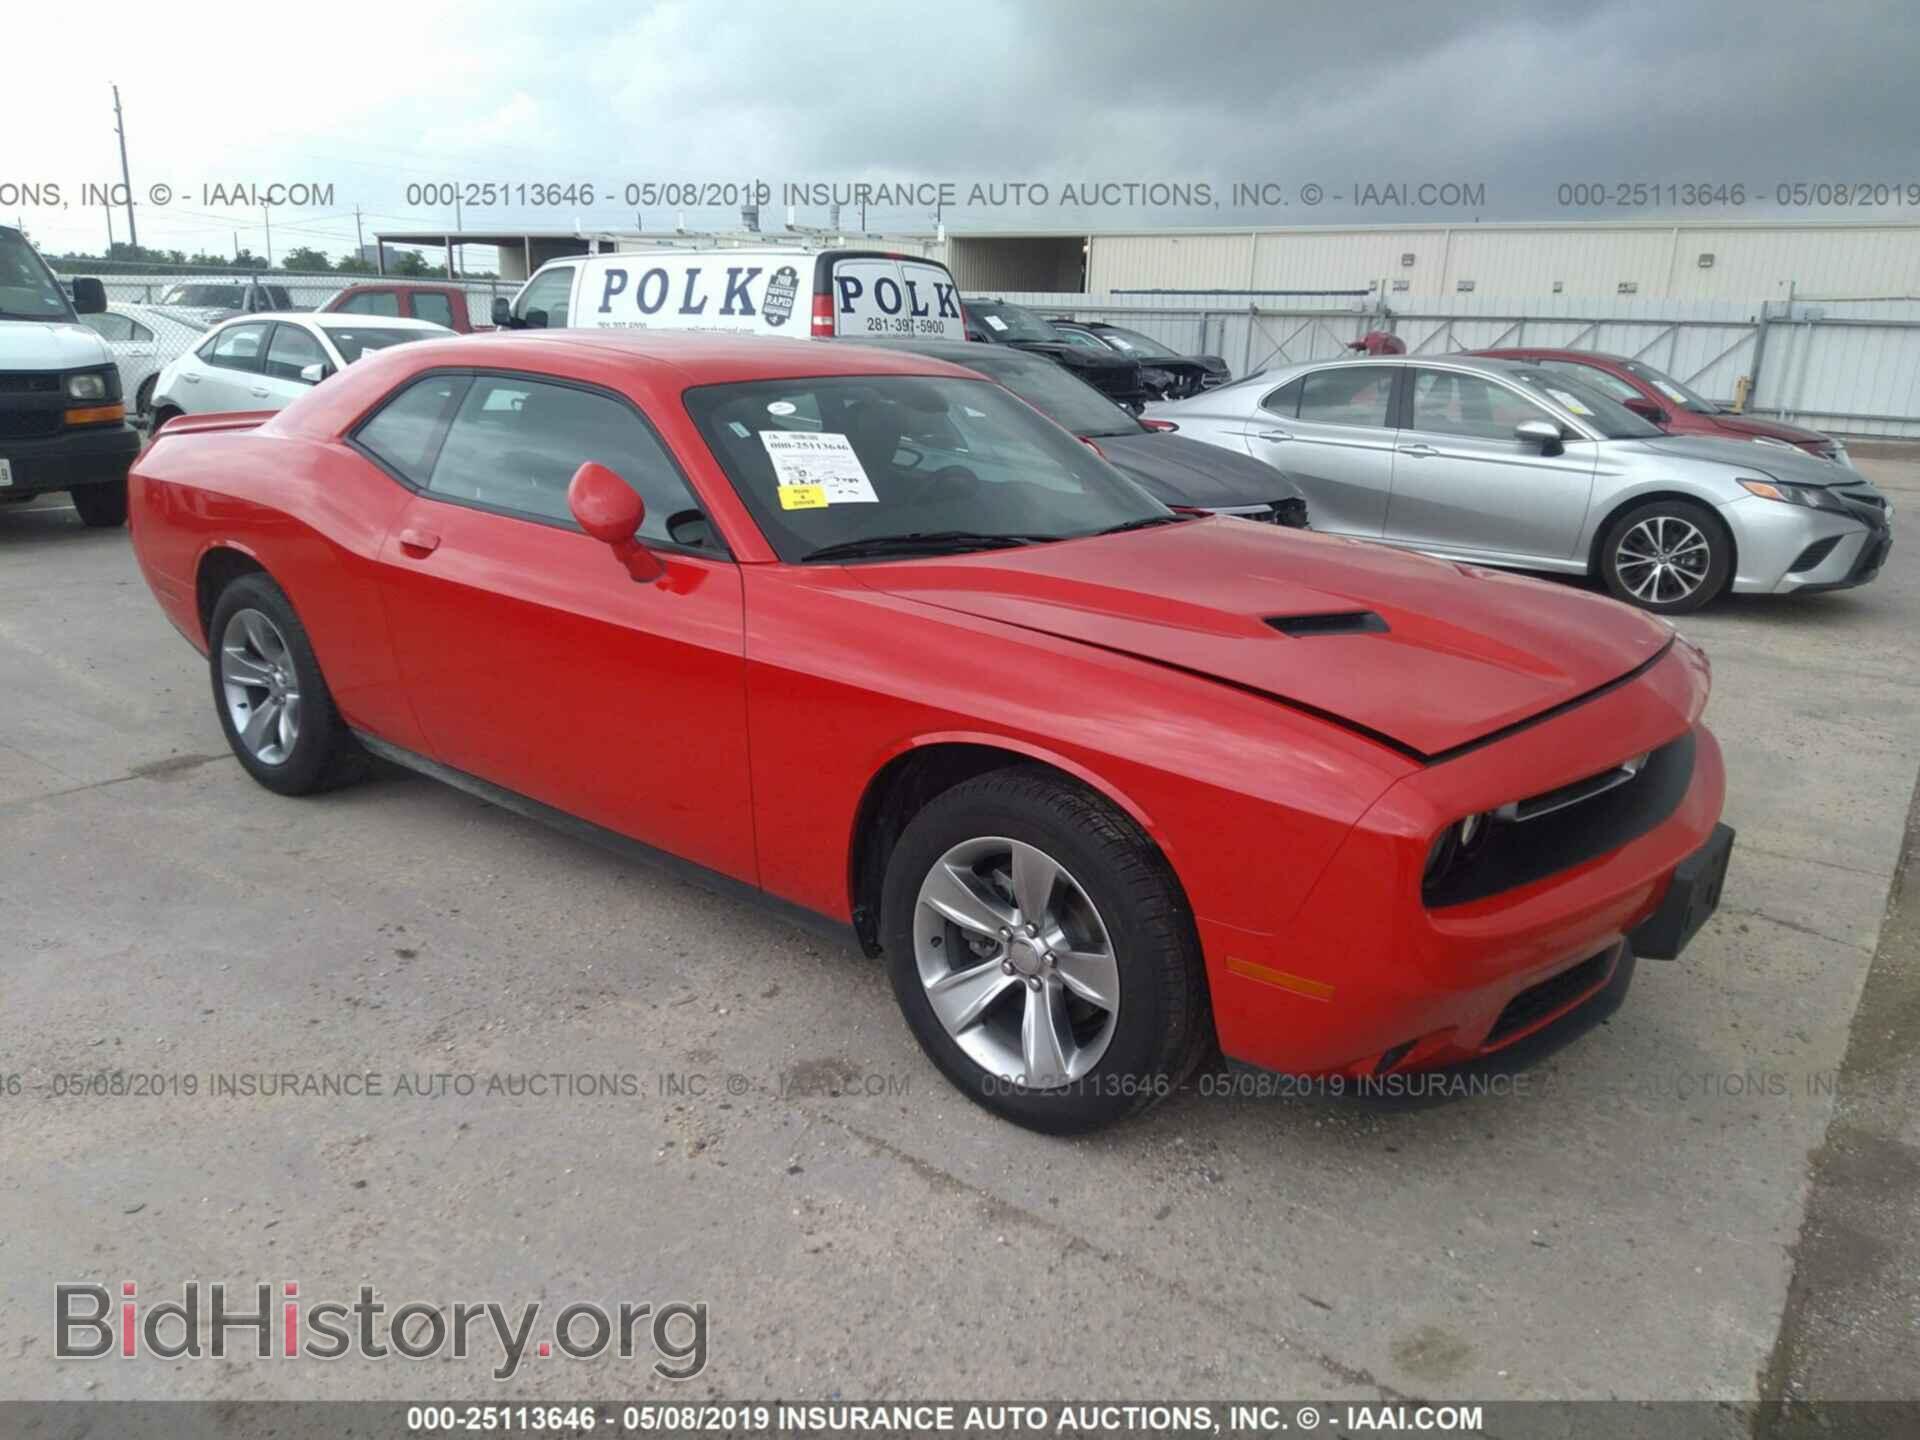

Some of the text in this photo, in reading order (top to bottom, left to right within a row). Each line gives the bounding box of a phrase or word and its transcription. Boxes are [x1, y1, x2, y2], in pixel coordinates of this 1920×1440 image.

[598, 267, 762, 315] POLK
[834, 276, 959, 319] POLK
[866, 317, 944, 334] 281-397-5900
